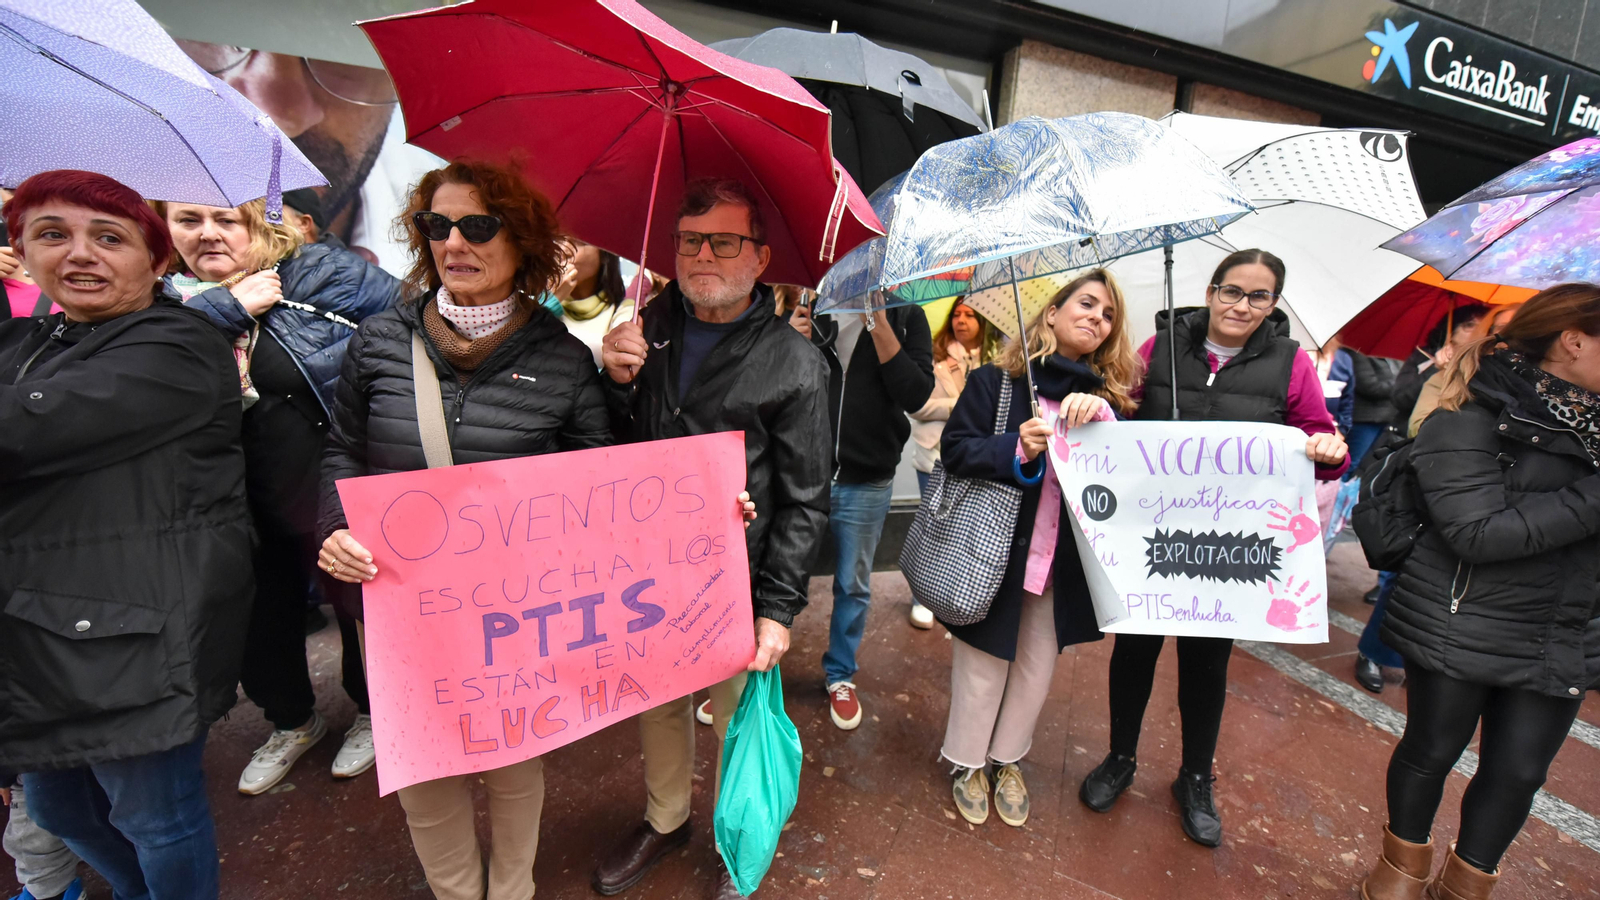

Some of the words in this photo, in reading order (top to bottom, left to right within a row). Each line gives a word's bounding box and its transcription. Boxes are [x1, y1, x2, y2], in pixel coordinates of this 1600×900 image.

[1423, 36, 1551, 116] CaixaBank
[1568, 94, 1600, 134] Em
[1070, 445, 1118, 474] mi
[1086, 489, 1109, 514] NO
[668, 534, 727, 566] L@S
[1153, 541, 1273, 566] EXPLOTACIÓN
[482, 578, 667, 667] PTIS
[434, 663, 557, 705] ESTÁN
[595, 635, 647, 670] EN
[459, 672, 650, 756] LUCHA
